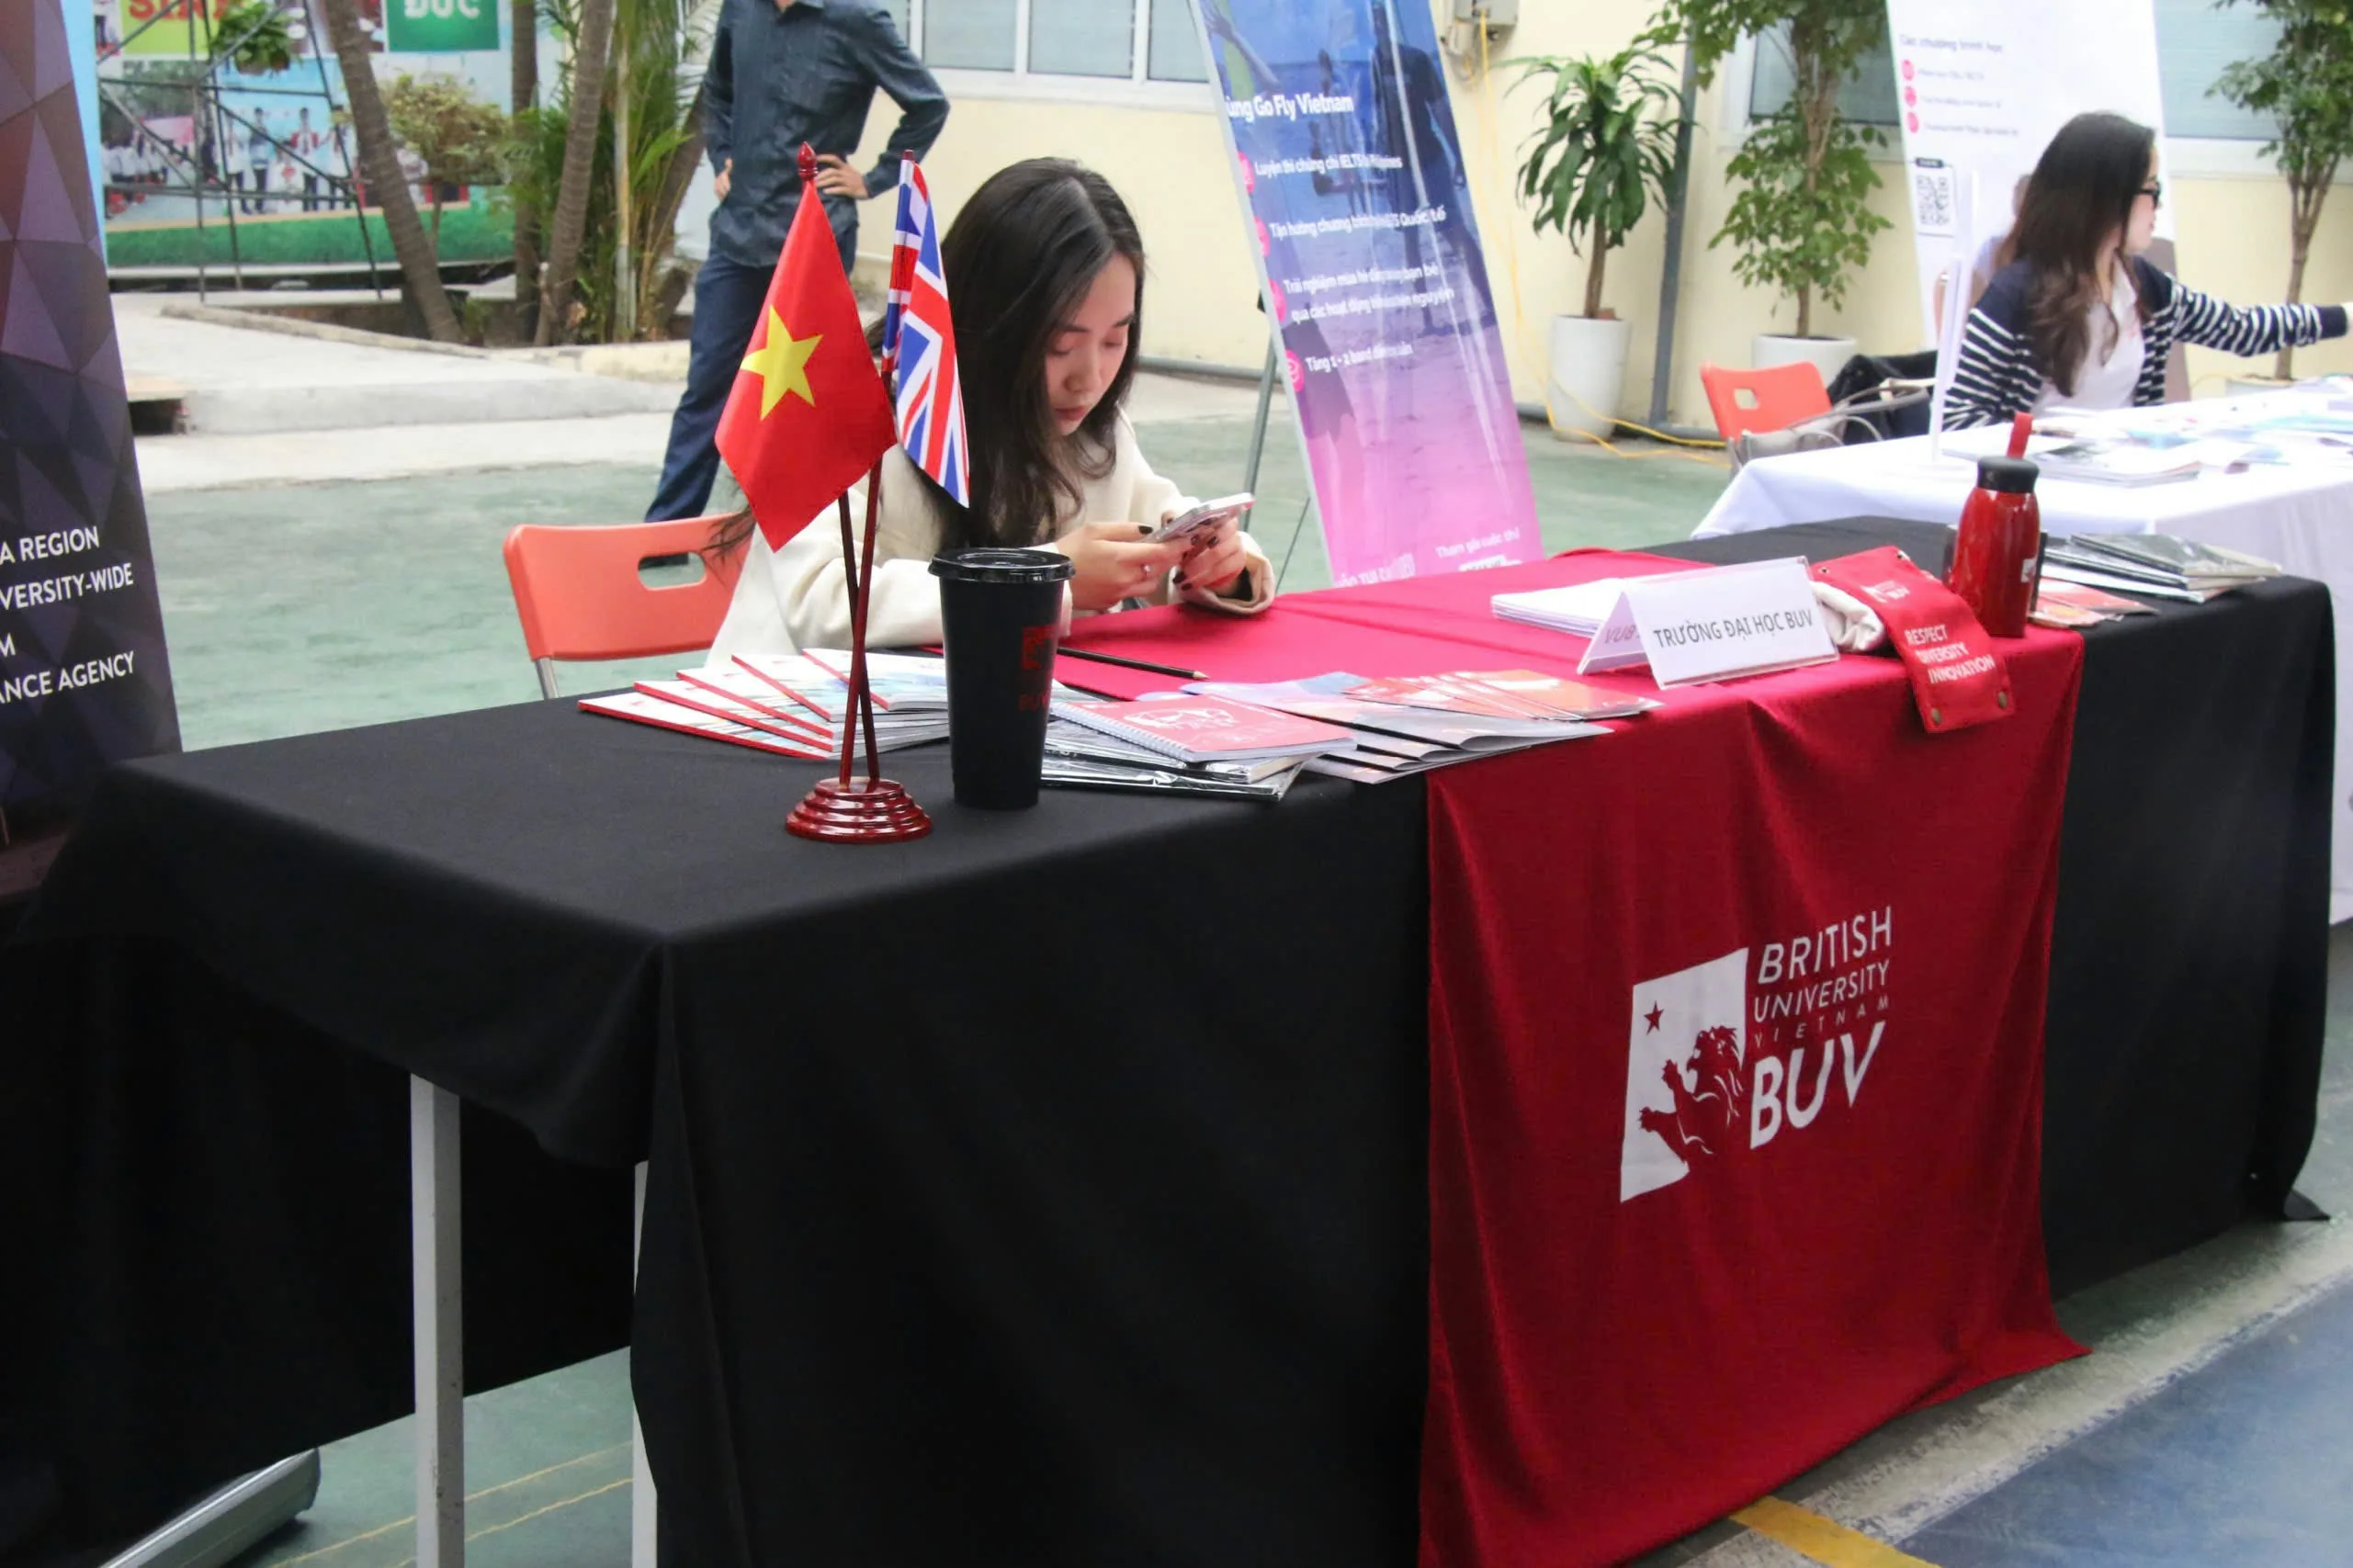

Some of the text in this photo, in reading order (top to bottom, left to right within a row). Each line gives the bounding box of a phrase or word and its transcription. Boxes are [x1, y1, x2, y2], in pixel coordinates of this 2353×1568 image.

[1253, 96, 1273, 117] Go
[1273, 94, 1296, 121] Fly
[1295, 93, 1354, 115] Vietnam
[19, 525, 100, 562] REGION
[1653, 608, 1814, 649] TRƯỜNG ĐẠI HỌC BUV
[1904, 624, 1949, 646] RESPECT
[58, 650, 135, 691] AGENCY
[1928, 654, 1996, 684] INNOVATION
[1757, 906, 1892, 985] BRITISH
[1754, 959, 1890, 1023] UNIVERSITY
[1754, 995, 1889, 1049] VIETNAM
[1749, 1021, 1886, 1150] BUV
